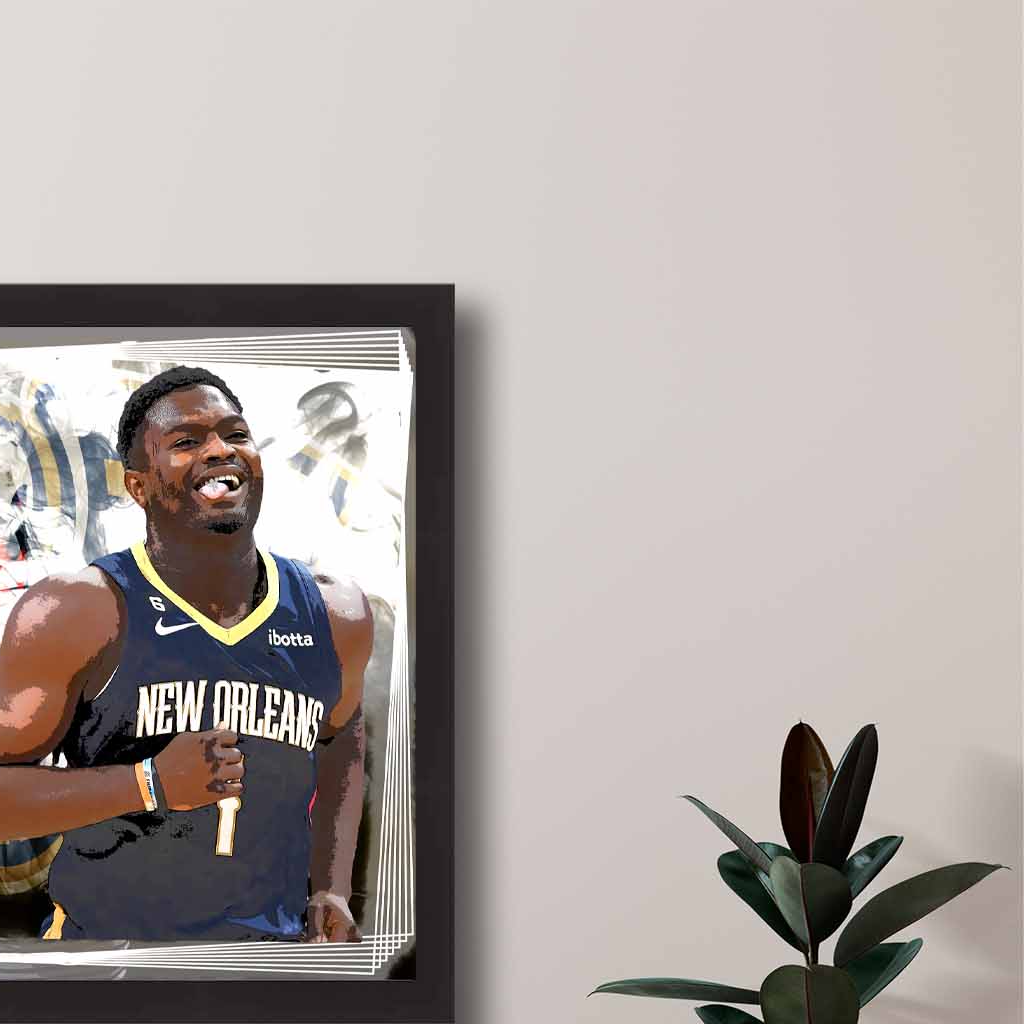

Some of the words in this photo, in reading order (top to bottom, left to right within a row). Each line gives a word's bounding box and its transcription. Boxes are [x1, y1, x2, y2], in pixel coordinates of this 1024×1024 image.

[149, 596, 166, 612] 6
[268, 629, 313, 647] ibotta
[136, 680, 207, 738] NEW
[212, 680, 325, 752] ORLEANS
